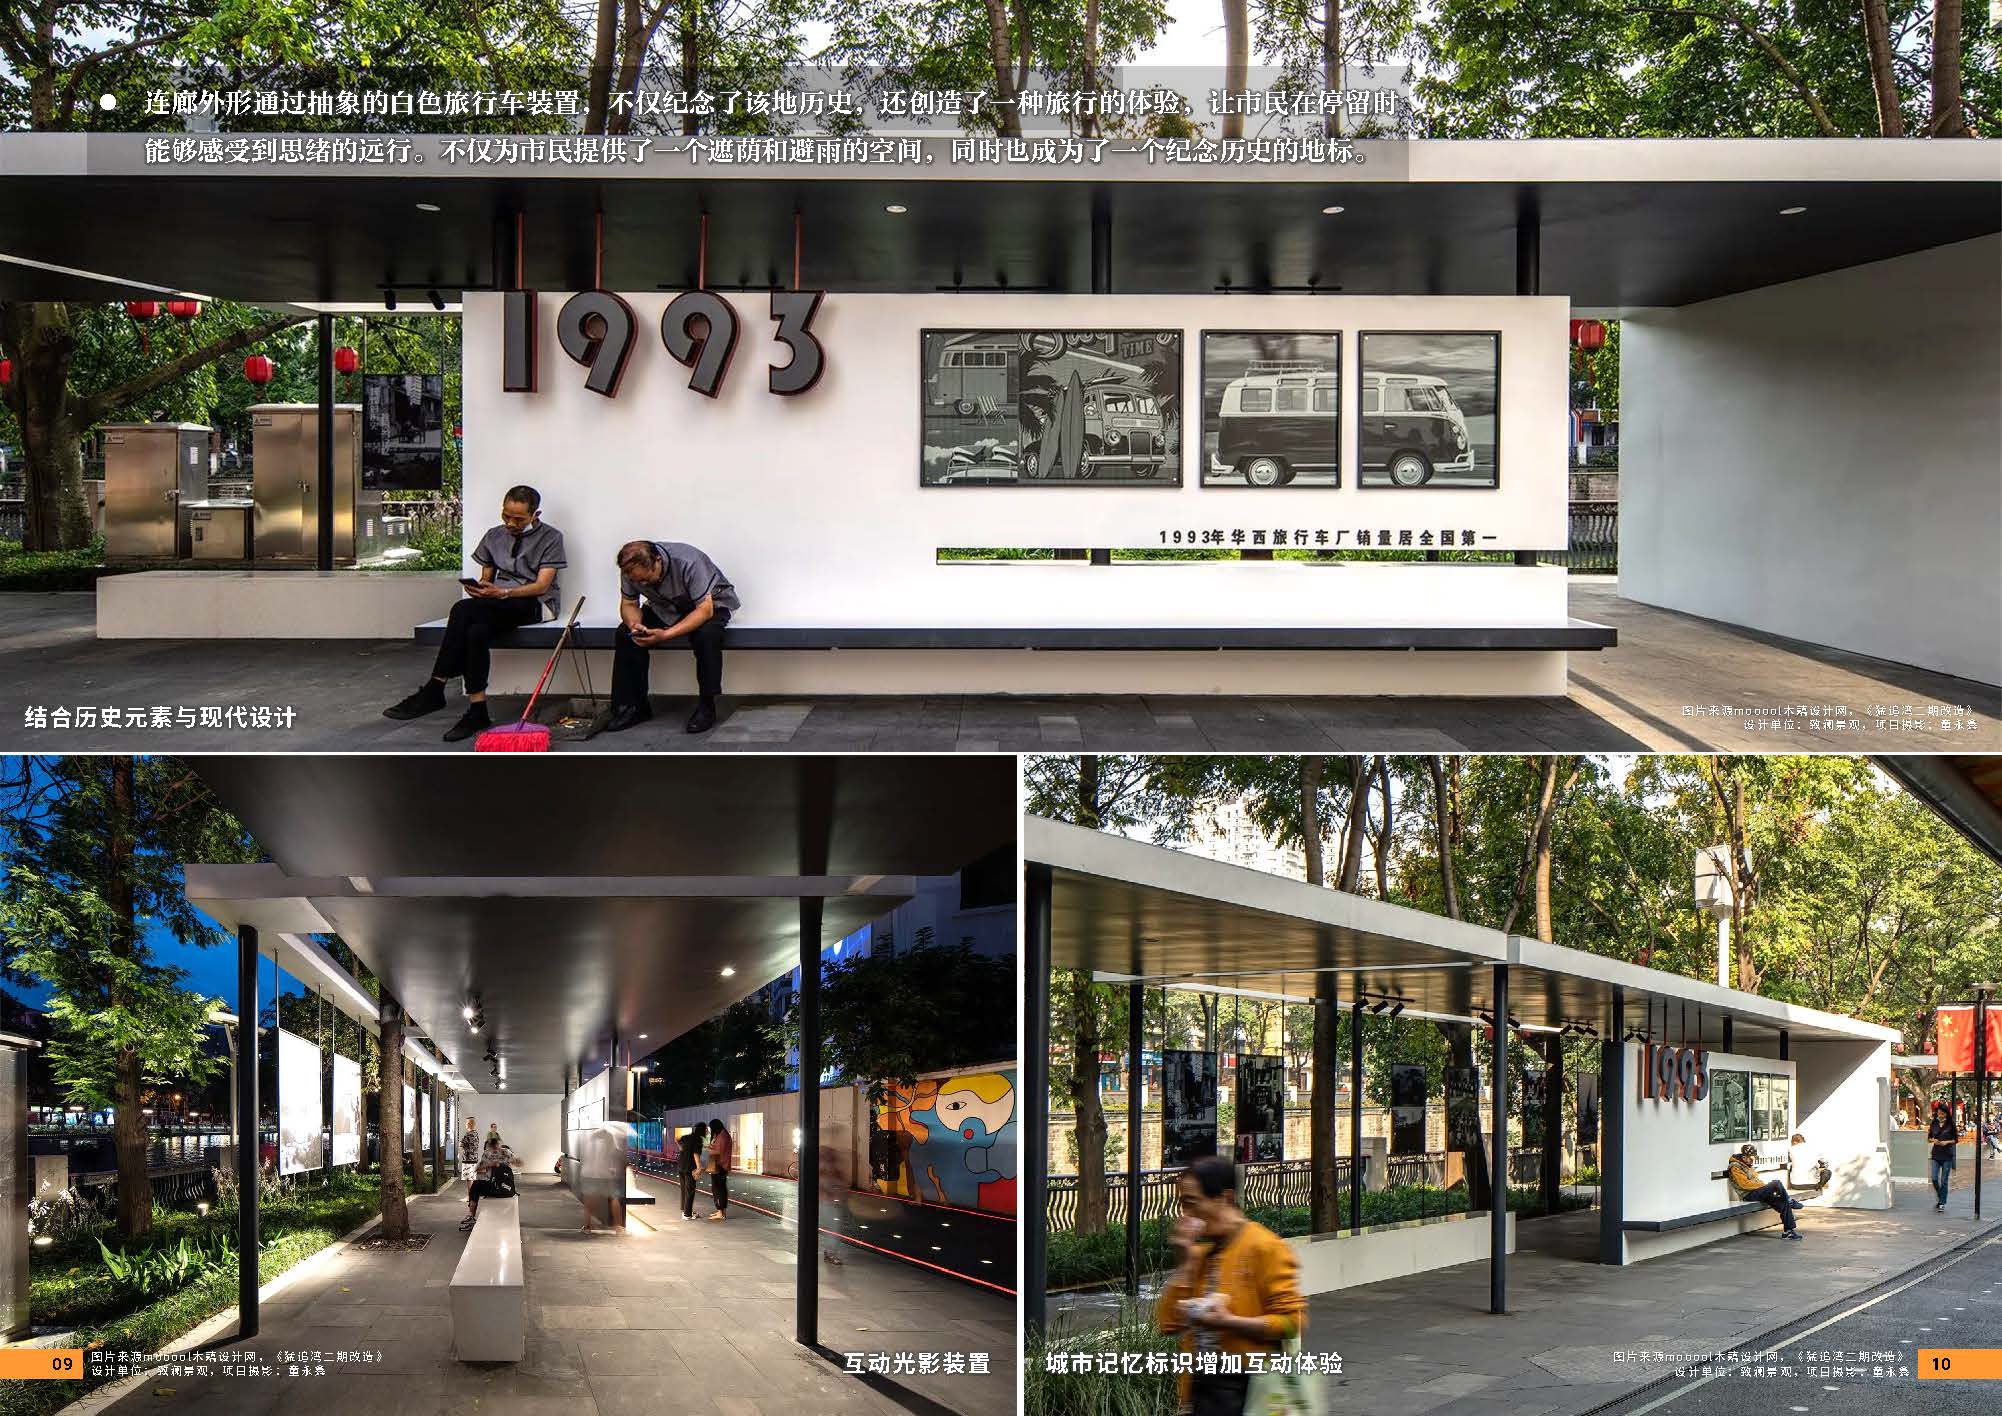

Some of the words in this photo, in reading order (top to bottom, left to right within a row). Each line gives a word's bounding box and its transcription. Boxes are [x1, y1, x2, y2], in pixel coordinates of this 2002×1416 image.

[503, 288, 826, 398] 1993
[1121, 339, 1153, 359] TIME
[1159, 529, 1498, 547] 1993年华西旅行车厂销量居全国第一
[1644, 1042, 1710, 1102] 1993
